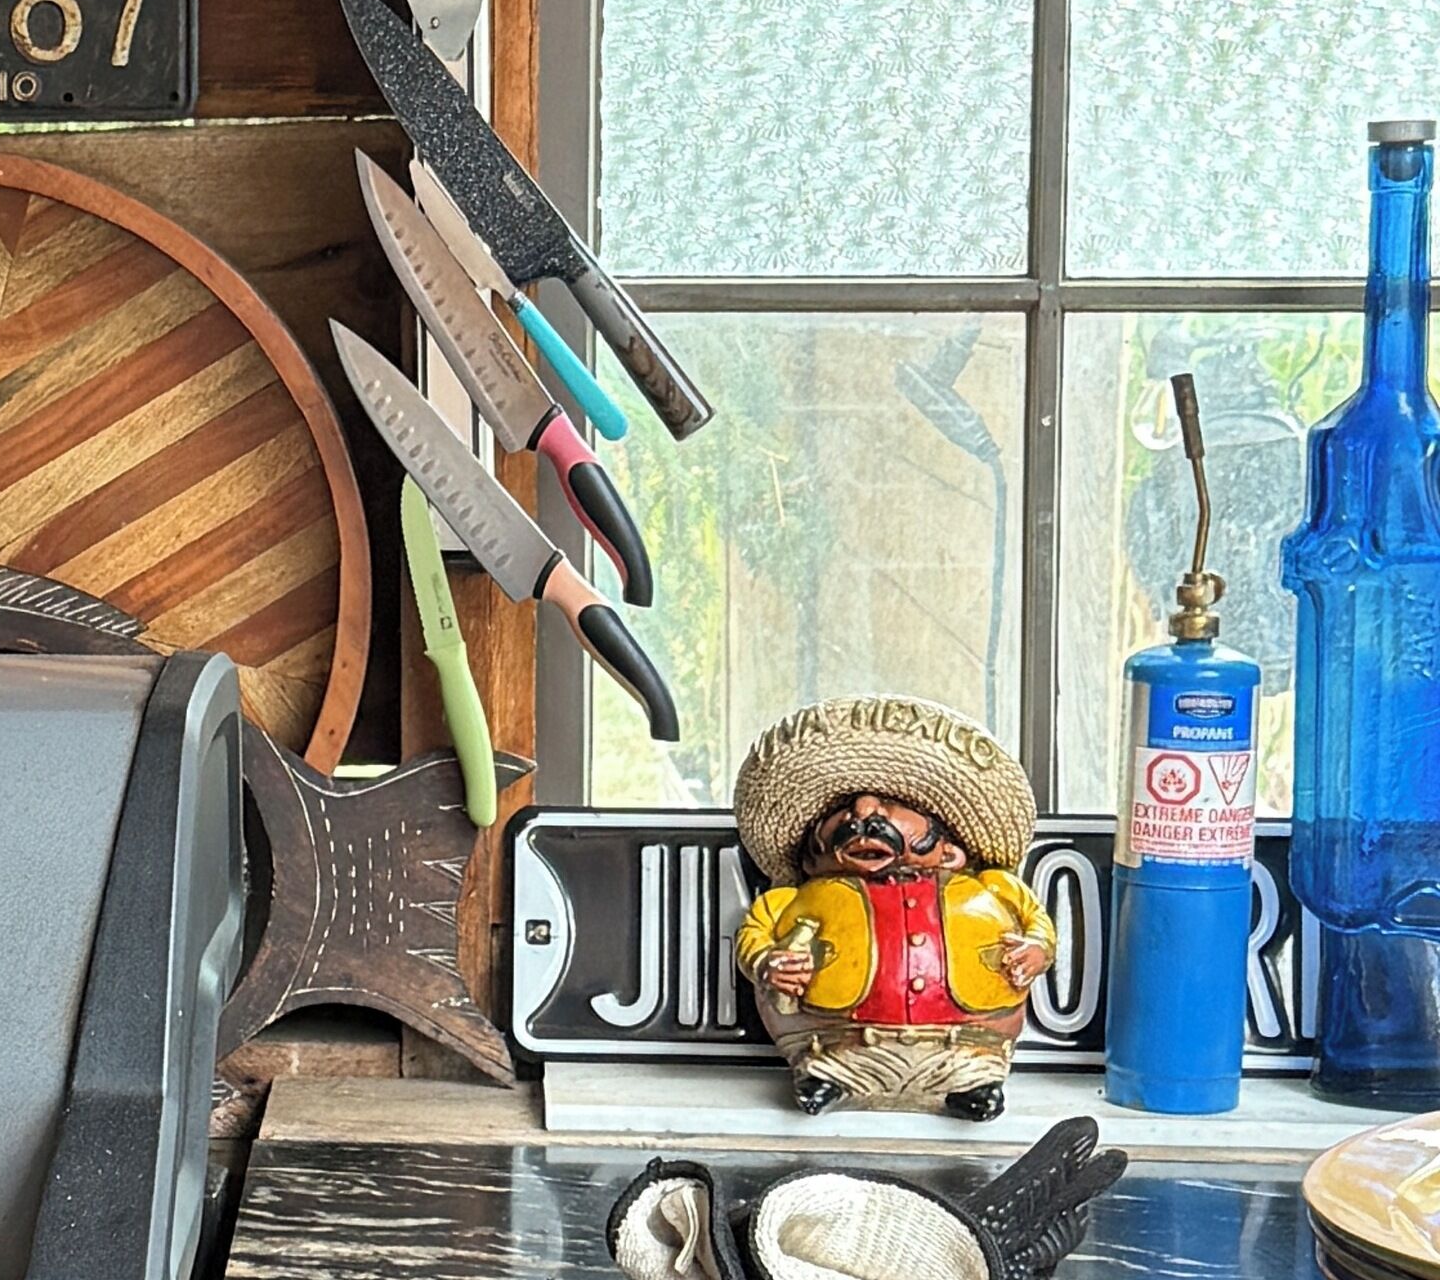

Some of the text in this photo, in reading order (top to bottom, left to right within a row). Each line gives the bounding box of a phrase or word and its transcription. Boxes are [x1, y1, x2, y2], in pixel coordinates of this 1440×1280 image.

[850, 697, 997, 769] MEXICO
[1134, 802, 1204, 824] EXTREME
[1133, 821, 1194, 841] DANGER
